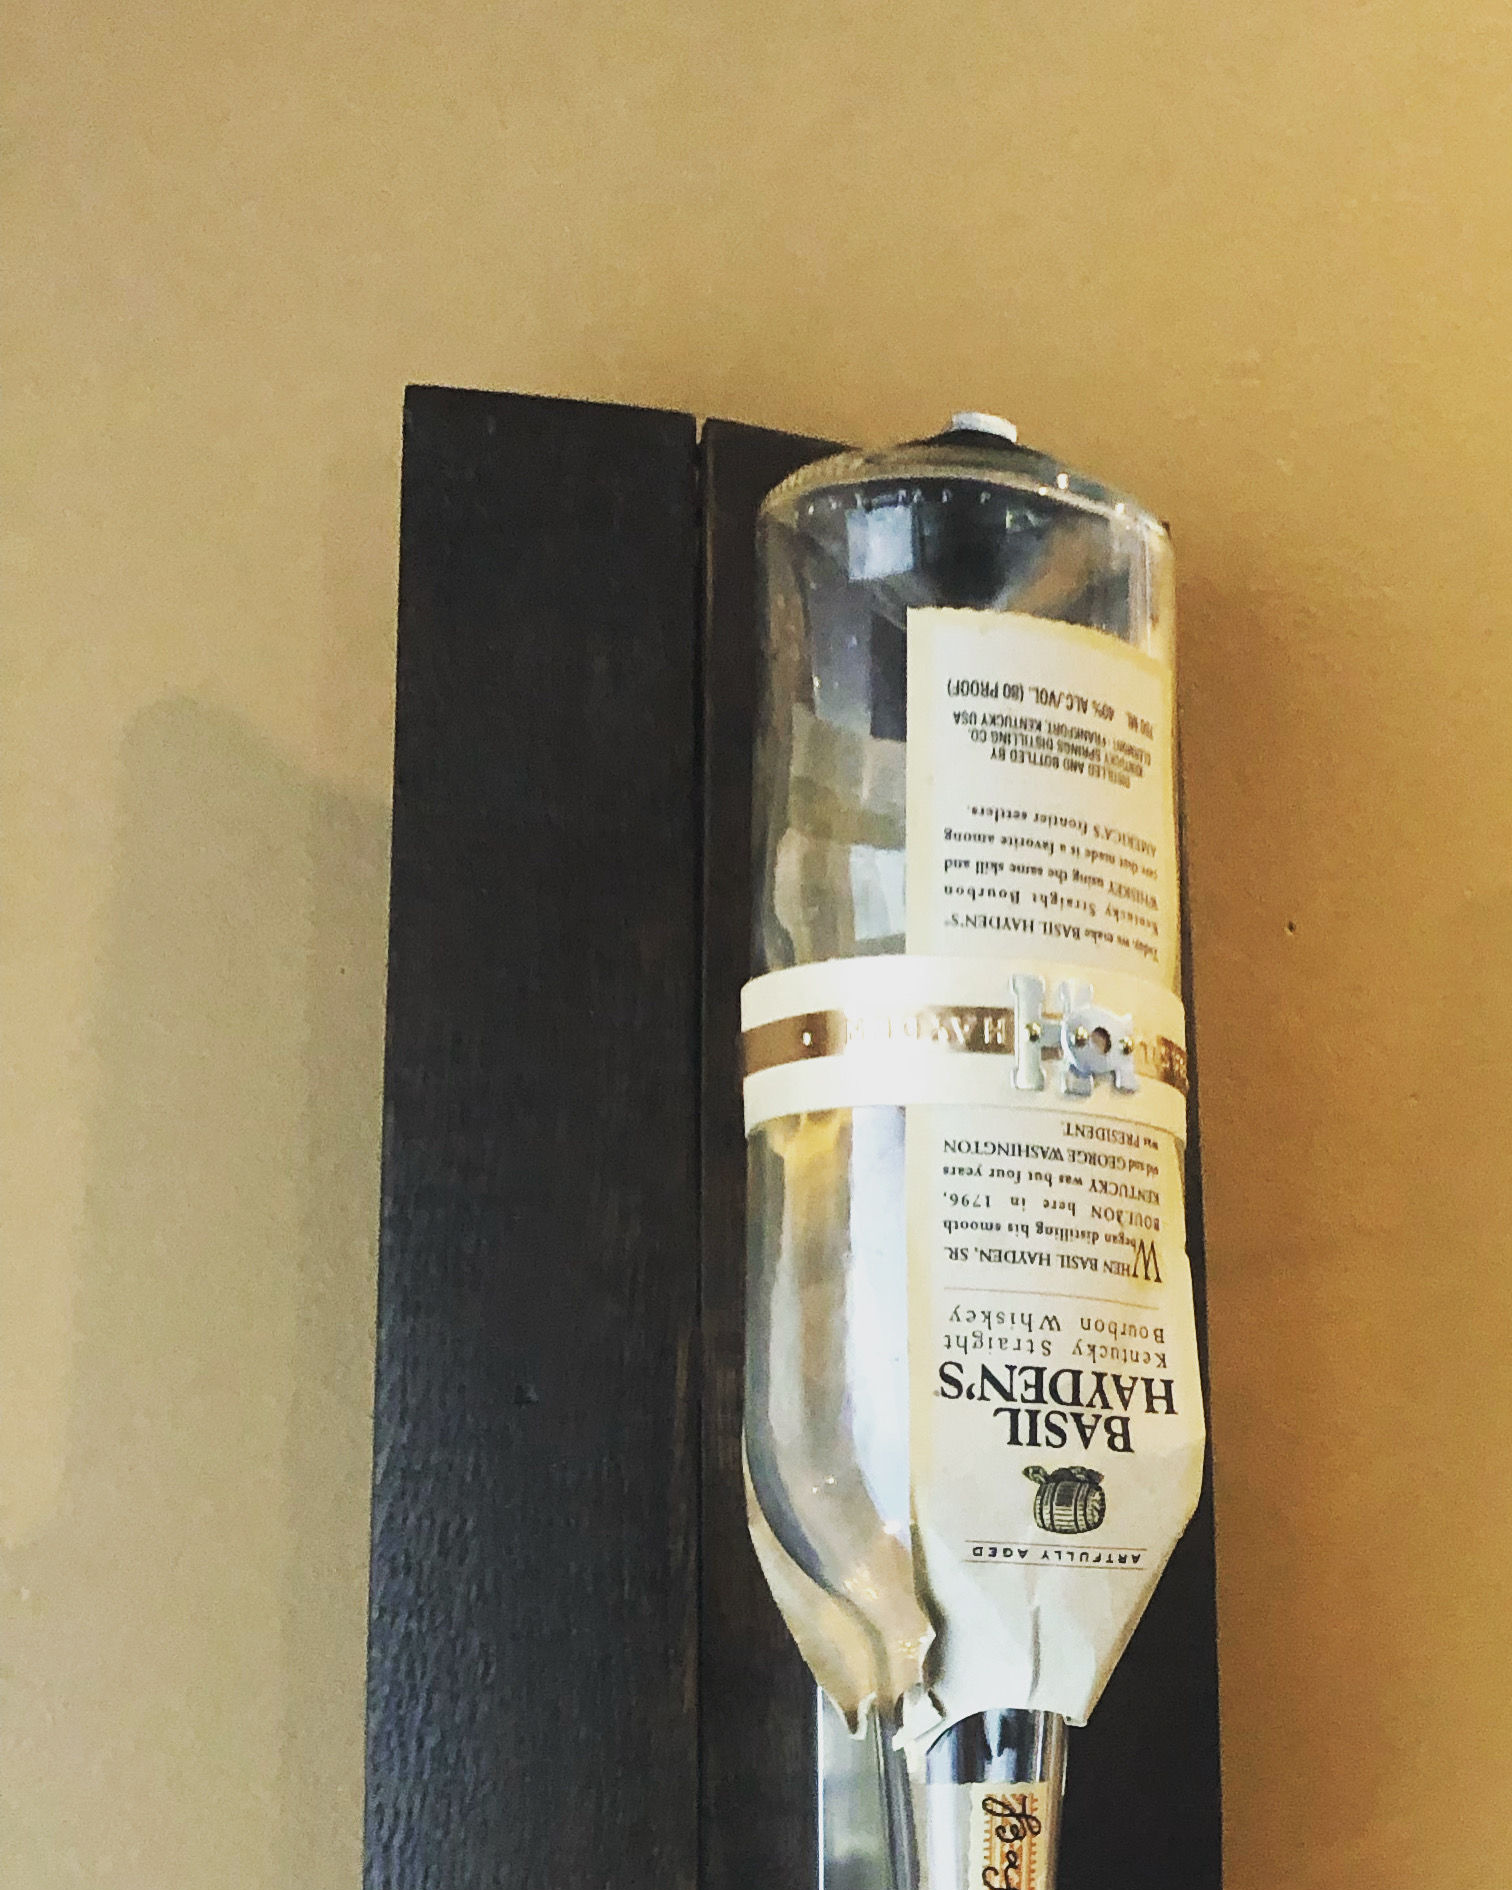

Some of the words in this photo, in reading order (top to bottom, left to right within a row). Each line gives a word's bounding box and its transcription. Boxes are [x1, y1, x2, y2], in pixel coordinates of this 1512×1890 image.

[947, 679, 999, 699] PROOF)
[1003, 682, 1024, 702] (80
[953, 710, 978, 726] USA
[1091, 700, 1115, 722] 40%
[981, 713, 1042, 732] KENTUCKY
[968, 729, 987, 743] CO.
[990, 730, 1054, 752] DISTILLING
[989, 747, 1006, 762] BY
[1009, 748, 1060, 771] BOTTLED
[1056, 739, 1101, 762] SPRINGS
[1062, 757, 1085, 775] AND
[966, 805, 1028, 823] settlers.
[1033, 812, 1088, 837] frontier
[943, 828, 995, 845] among
[1000, 835, 1055, 855] favorite
[1093, 824, 1157, 858] AMERICA'S
[944, 858, 970, 873] and
[975, 860, 1004, 877] skill
[1085, 849, 1116, 868] made
[1119, 856, 1138, 877] that
[1009, 863, 1044, 879] same
[1047, 868, 1068, 886] the
[1072, 869, 1104, 889] using
[943, 885, 1020, 905] Bourbon
[1032, 892, 1096, 918] Straight
[1107, 880, 1158, 911] WHISKEY
[950, 913, 1034, 933] HAYDEN'S
[1105, 903, 1158, 937] Kentucky
[1036, 920, 1080, 941] BASIL
[1085, 928, 1113, 944] make
[943, 1139, 1063, 1163] WASHINGTON
[1143, 1136, 1158, 1151] was
[1067, 1148, 1126, 1171] GEORGE
[942, 1163, 982, 1178] years
[989, 1168, 1021, 1184] four
[1027, 1171, 1052, 1188] but
[1059, 1174, 1083, 1187] was
[1088, 1178, 1160, 1206] KENTUCKY
[1010, 1196, 1026, 1213] in
[1042, 1199, 1076, 1217] here
[943, 1219, 1002, 1235] smooth
[1007, 1222, 1029, 1239] his
[1035, 1221, 1099, 1246] distilling
[1104, 1231, 1137, 1250] began
[943, 1247, 969, 1262] SR.
[974, 1247, 1051, 1267] HAYDEN,
[1056, 1254, 1098, 1271] BASIL
[1103, 1239, 1162, 1283] WHEN
[948, 1305, 1061, 1333] Whiskey
[1079, 1317, 1165, 1344] Bourbon
[943, 1330, 1052, 1358] Straight
[1072, 1338, 1167, 1369] Kentucky
[938, 1360, 1178, 1416] HAYDEN'S
[992, 1407, 1135, 1454] BASIL
[971, 1546, 1028, 1560] AGED
[1040, 1549, 1141, 1565] ARTFULLY
